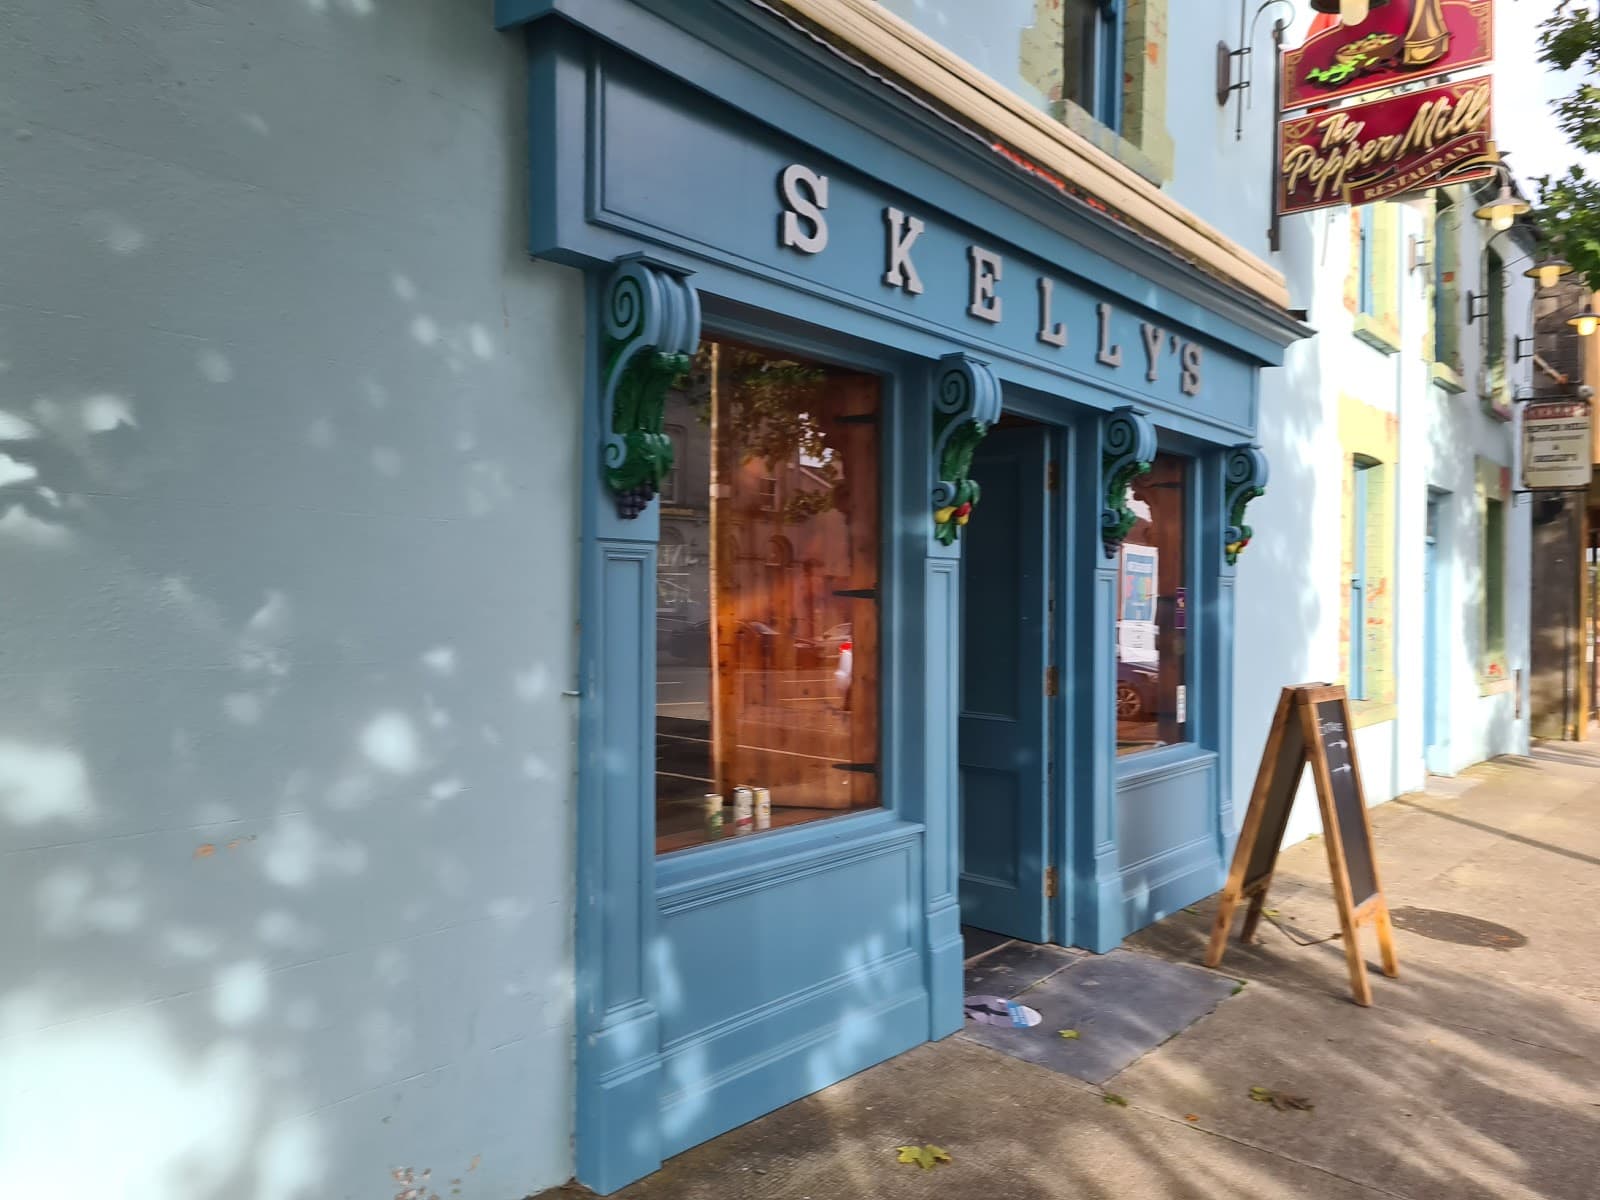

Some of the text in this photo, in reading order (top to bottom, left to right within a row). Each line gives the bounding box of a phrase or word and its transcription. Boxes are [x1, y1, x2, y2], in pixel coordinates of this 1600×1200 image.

[1282, 82, 1490, 202] Pepper Mill
[1318, 112, 1365, 149] The
[1363, 138, 1481, 198] RESTAURANT
[779, 164, 1202, 396] SKELLY'S
